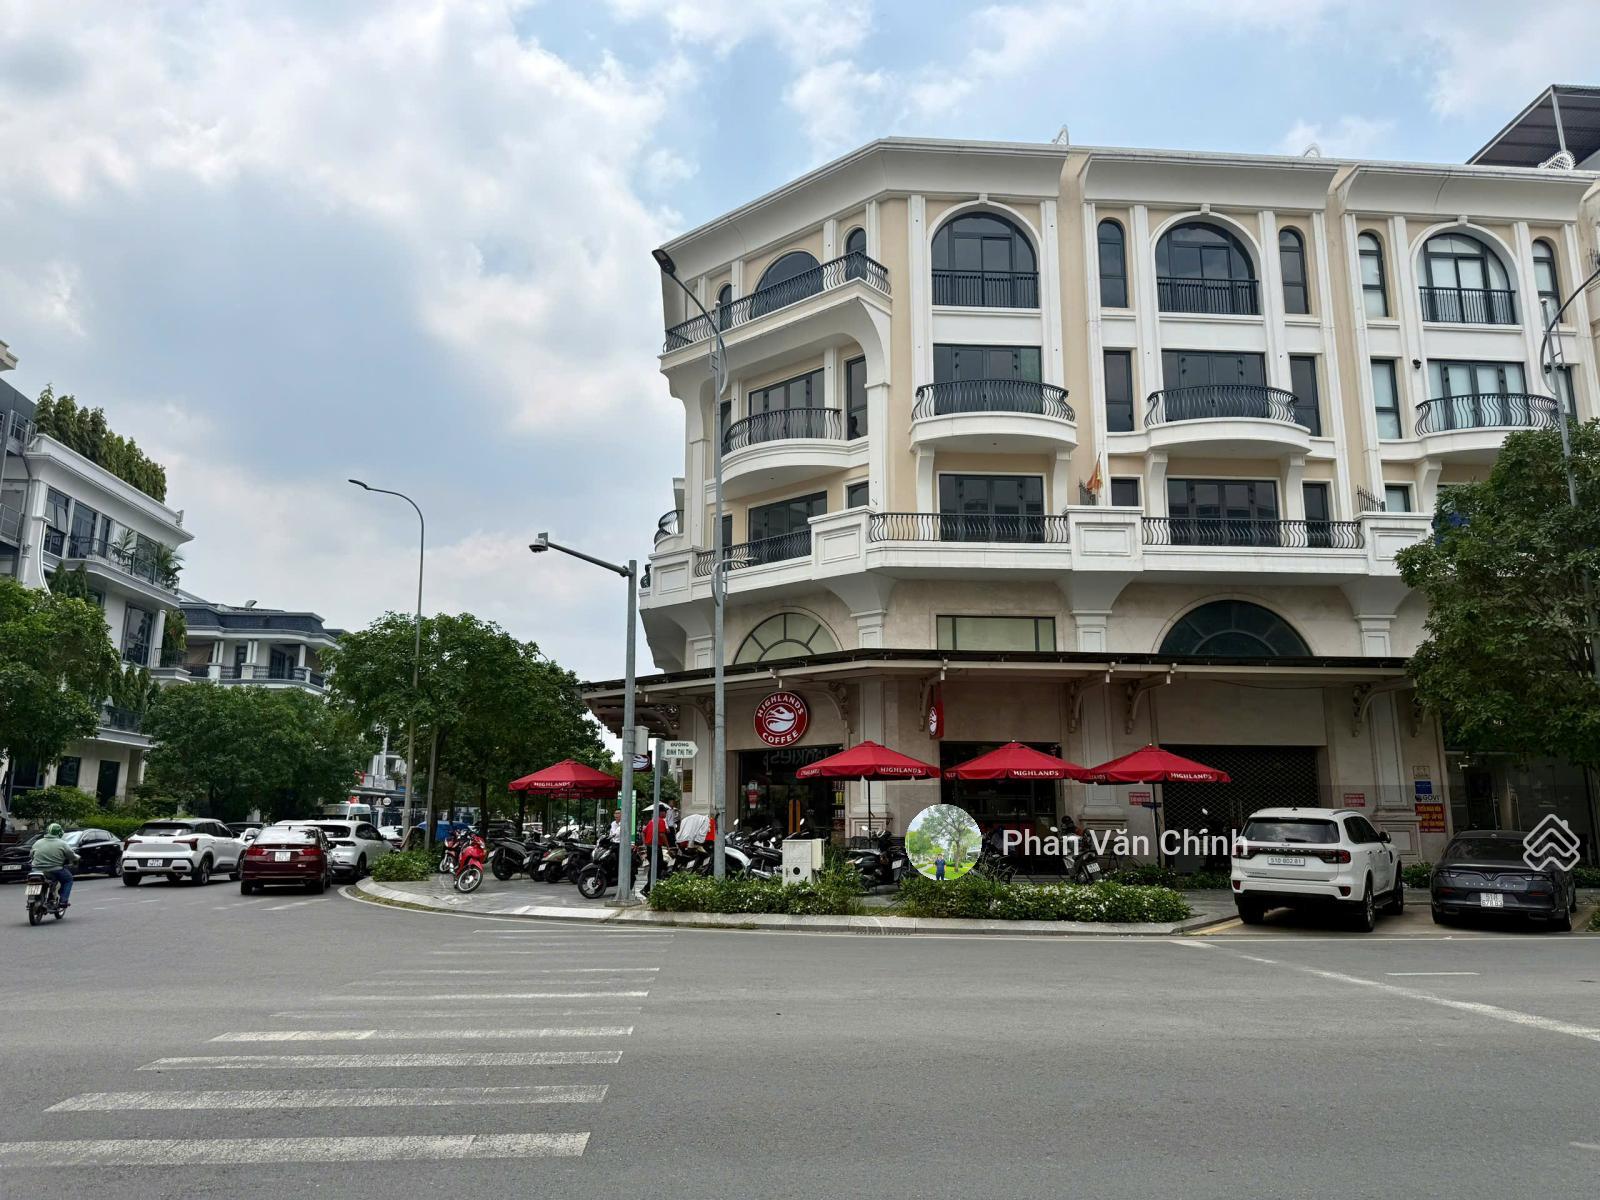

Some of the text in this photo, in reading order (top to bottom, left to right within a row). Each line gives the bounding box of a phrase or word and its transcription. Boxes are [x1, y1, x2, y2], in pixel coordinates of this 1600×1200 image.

[757, 694, 804, 717] HIGHLANDS
[762, 730, 799, 743] COFFEE
[1170, 772, 1213, 780] HIGHLANDS
